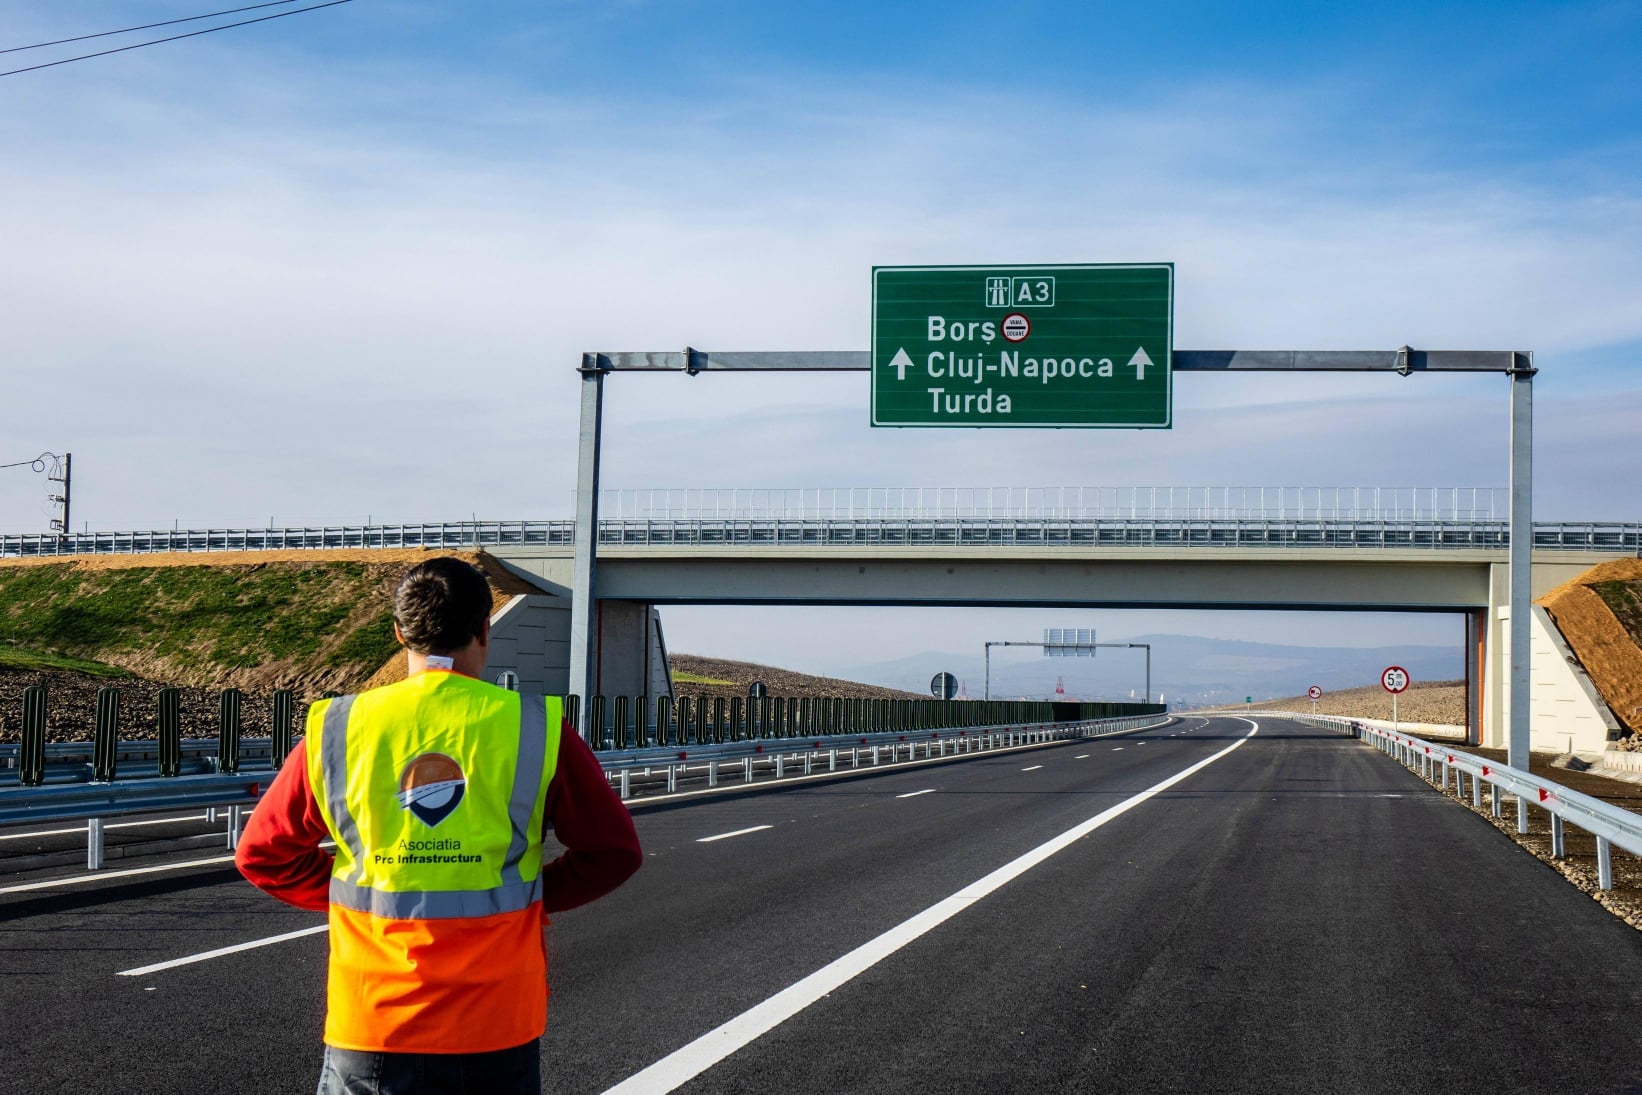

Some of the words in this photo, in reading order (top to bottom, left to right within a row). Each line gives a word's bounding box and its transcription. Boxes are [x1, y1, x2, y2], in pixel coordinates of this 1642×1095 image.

[1017, 282, 1049, 302] A3
[928, 315, 996, 345] Borș
[928, 351, 1113, 384] Cluj-Napoca
[928, 388, 1012, 413] Turda
[398, 838, 461, 851] Asociatia
[398, 854, 482, 864] Infrastructura
